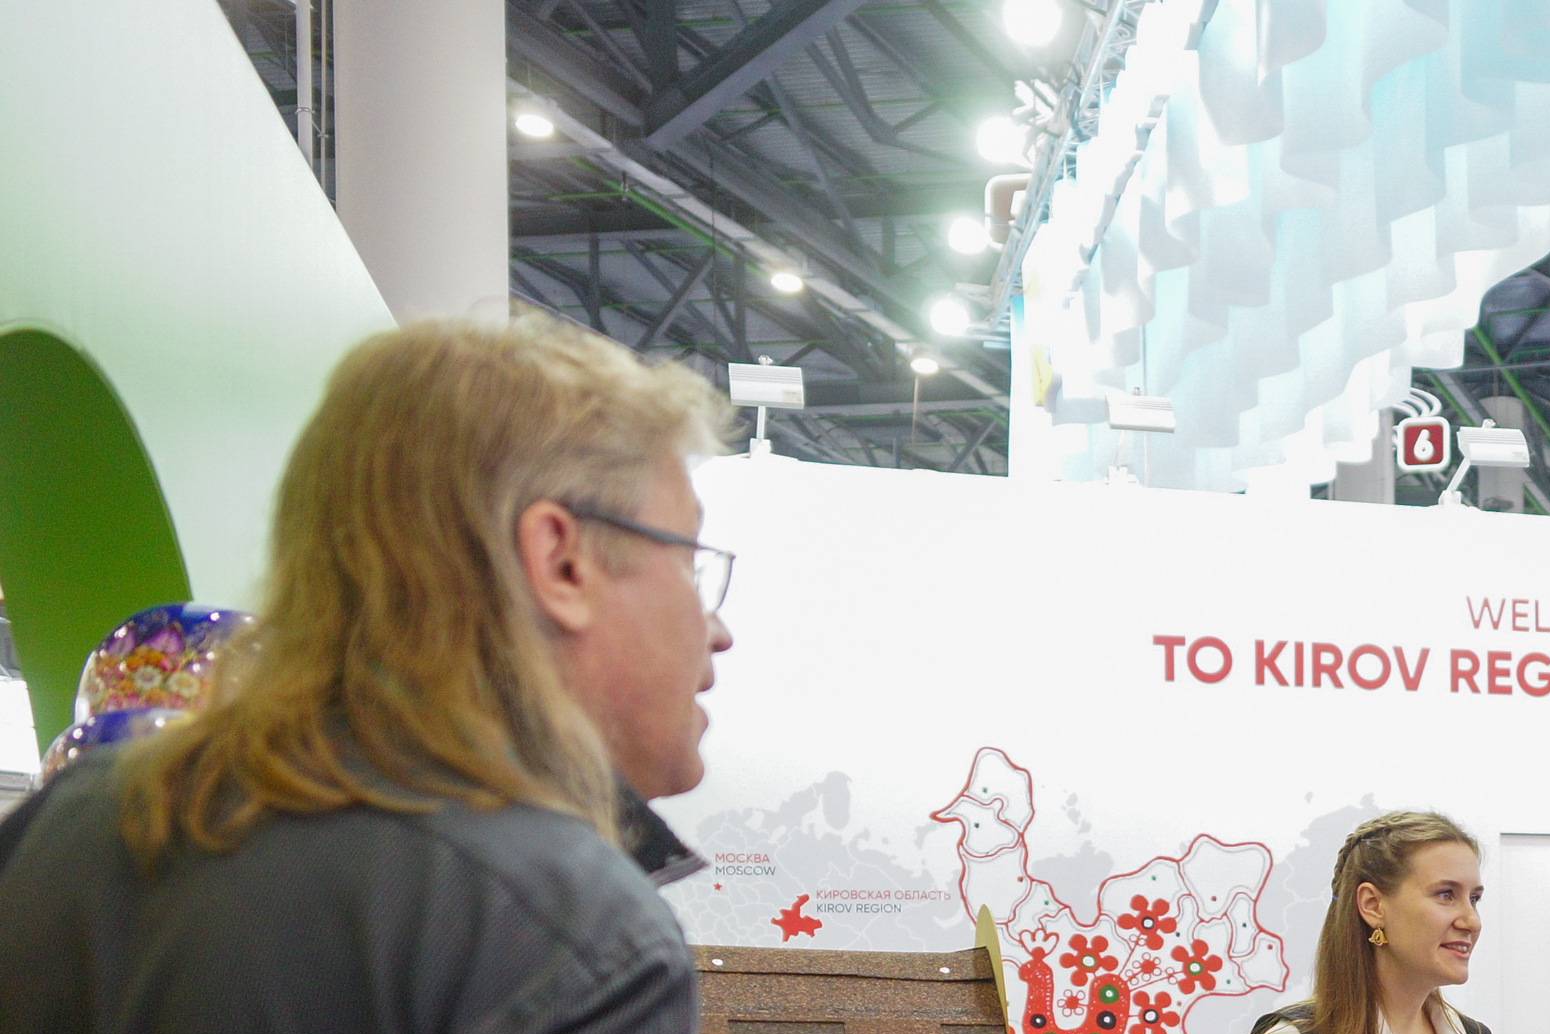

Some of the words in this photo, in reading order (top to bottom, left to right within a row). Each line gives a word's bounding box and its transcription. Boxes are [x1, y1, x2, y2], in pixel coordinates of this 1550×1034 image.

[1152, 634, 1233, 685] TO
[1254, 639, 1431, 693] KIROV
[715, 853, 770, 864] МОСКВА
[715, 866, 776, 876] MOSCOW
[815, 890, 891, 900] КИРОВСКАЯ
[894, 890, 951, 901] ОБЛАСТЬ
[815, 903, 852, 914] KIROV
[855, 903, 902, 914] REGION
